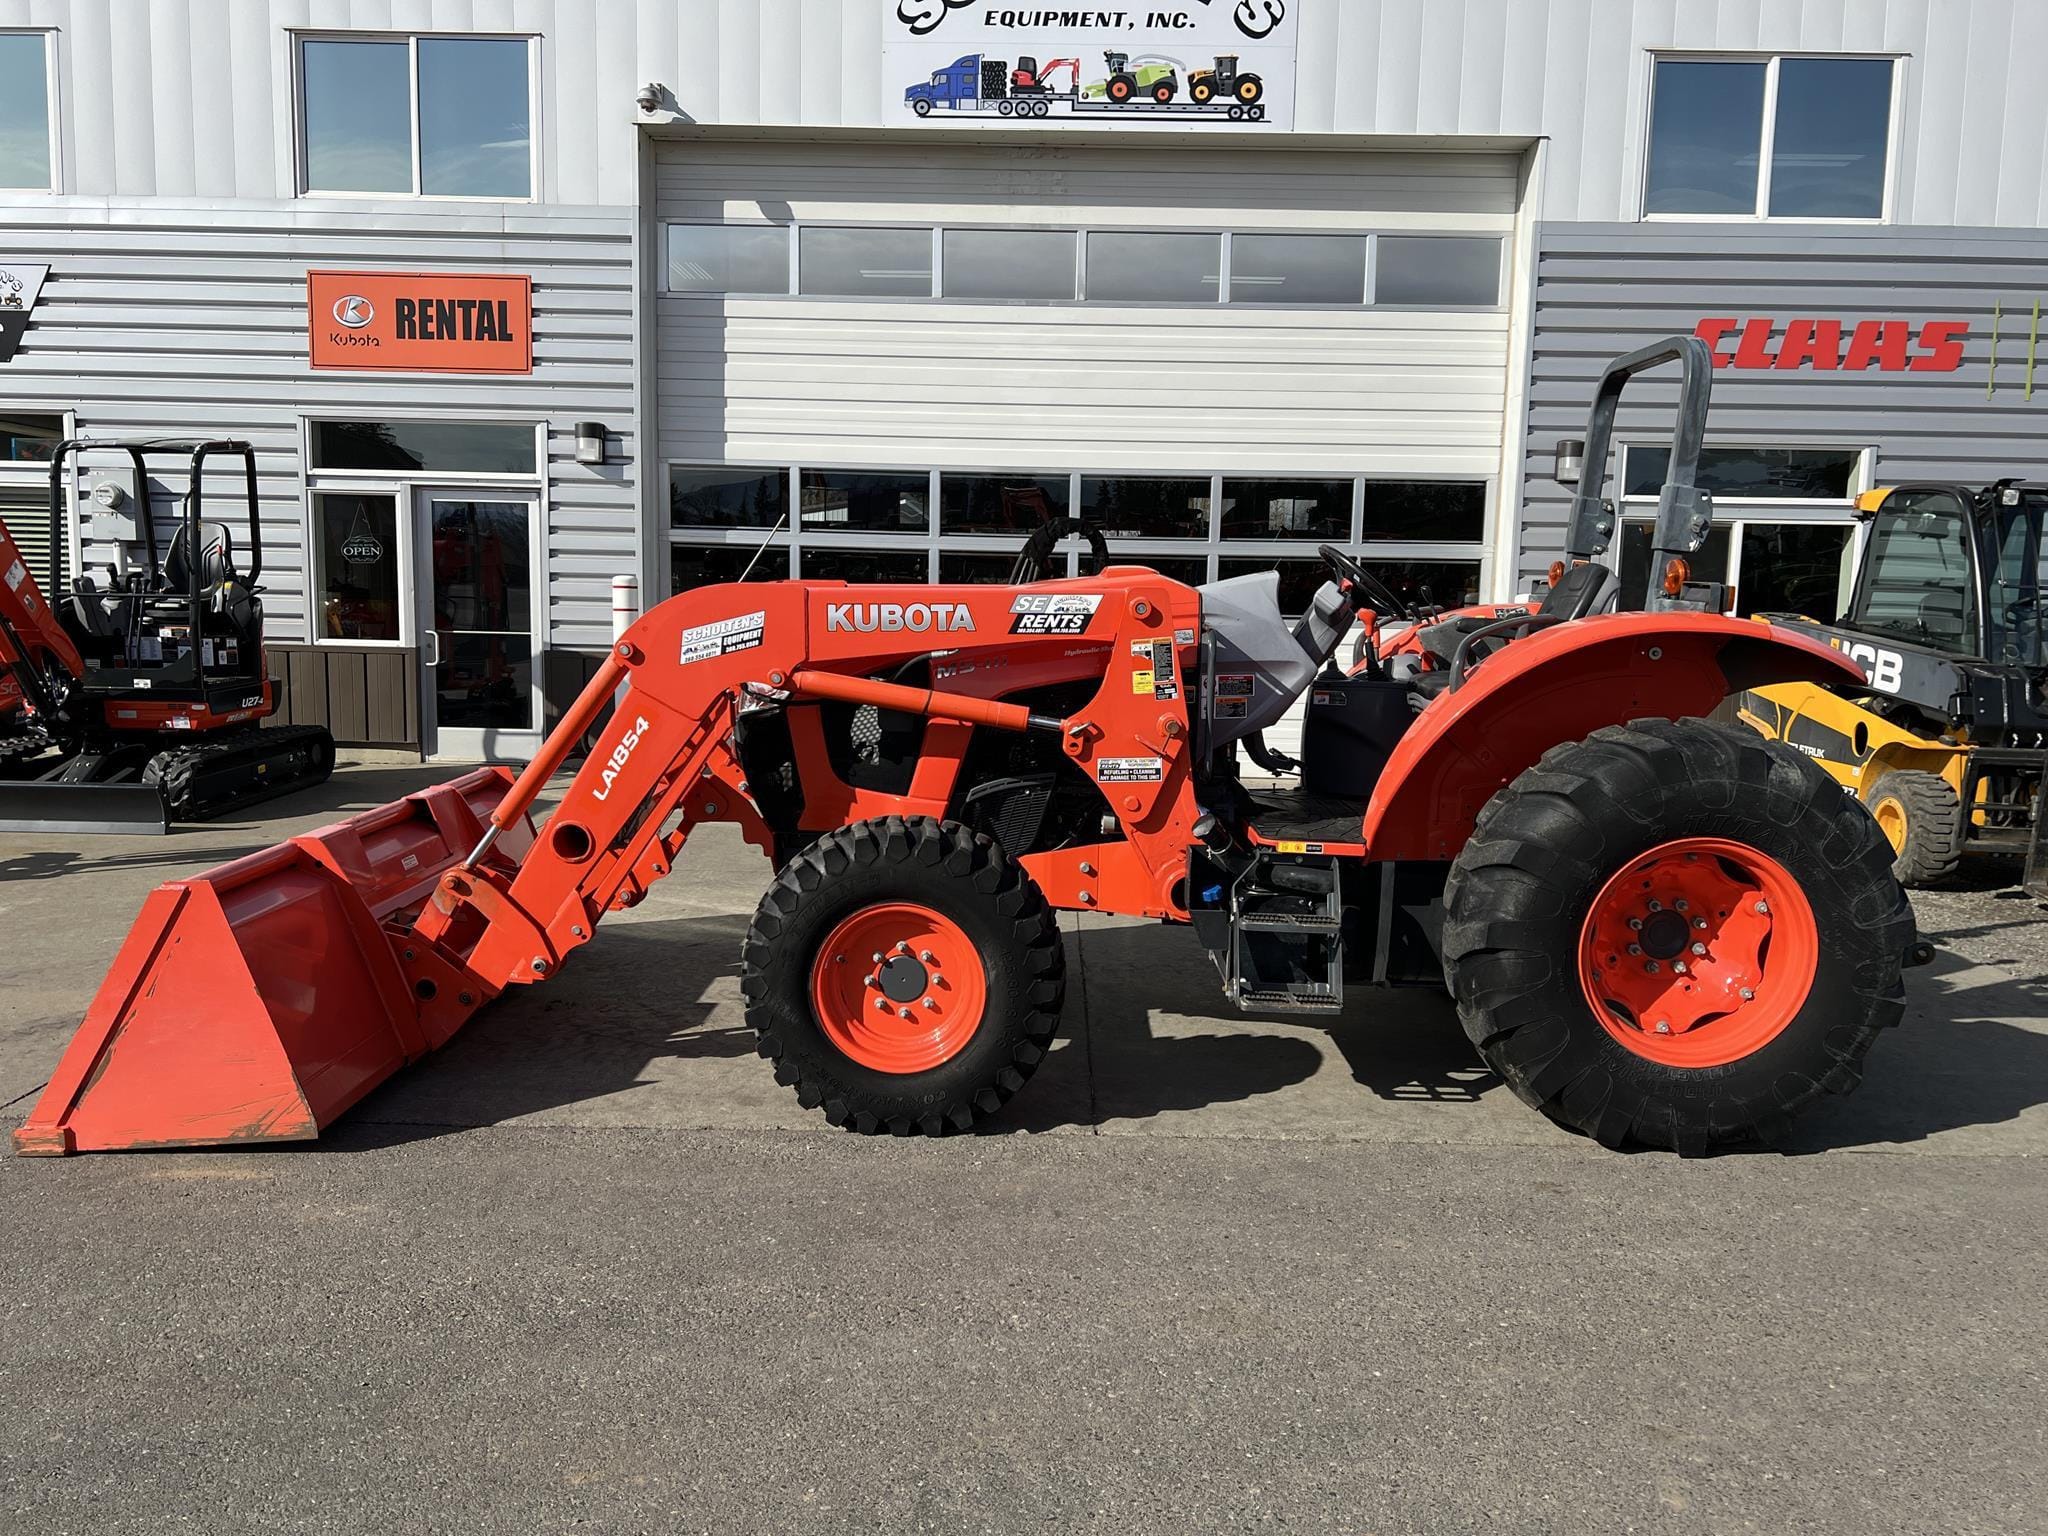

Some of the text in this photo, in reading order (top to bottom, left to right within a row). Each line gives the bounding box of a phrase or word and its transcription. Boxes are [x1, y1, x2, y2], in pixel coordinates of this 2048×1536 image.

[984, 10, 1135, 31] EQUIPMENT,
[1145, 12, 1196, 29] INC.
[395, 298, 513, 342] RENTAL
[329, 332, 380, 347] Kubota
[1694, 318, 1970, 372] CLAAS
[343, 546, 380, 556] OPEN
[1015, 596, 1048, 611] SE
[827, 602, 977, 632] KUBOTA
[1019, 614, 1086, 628] RENTS
[684, 614, 763, 643] SCHOLTEN'S
[723, 629, 763, 646] EQUIPMENT
[242, 695, 264, 708] U27-4
[592, 716, 650, 801] LA1854
